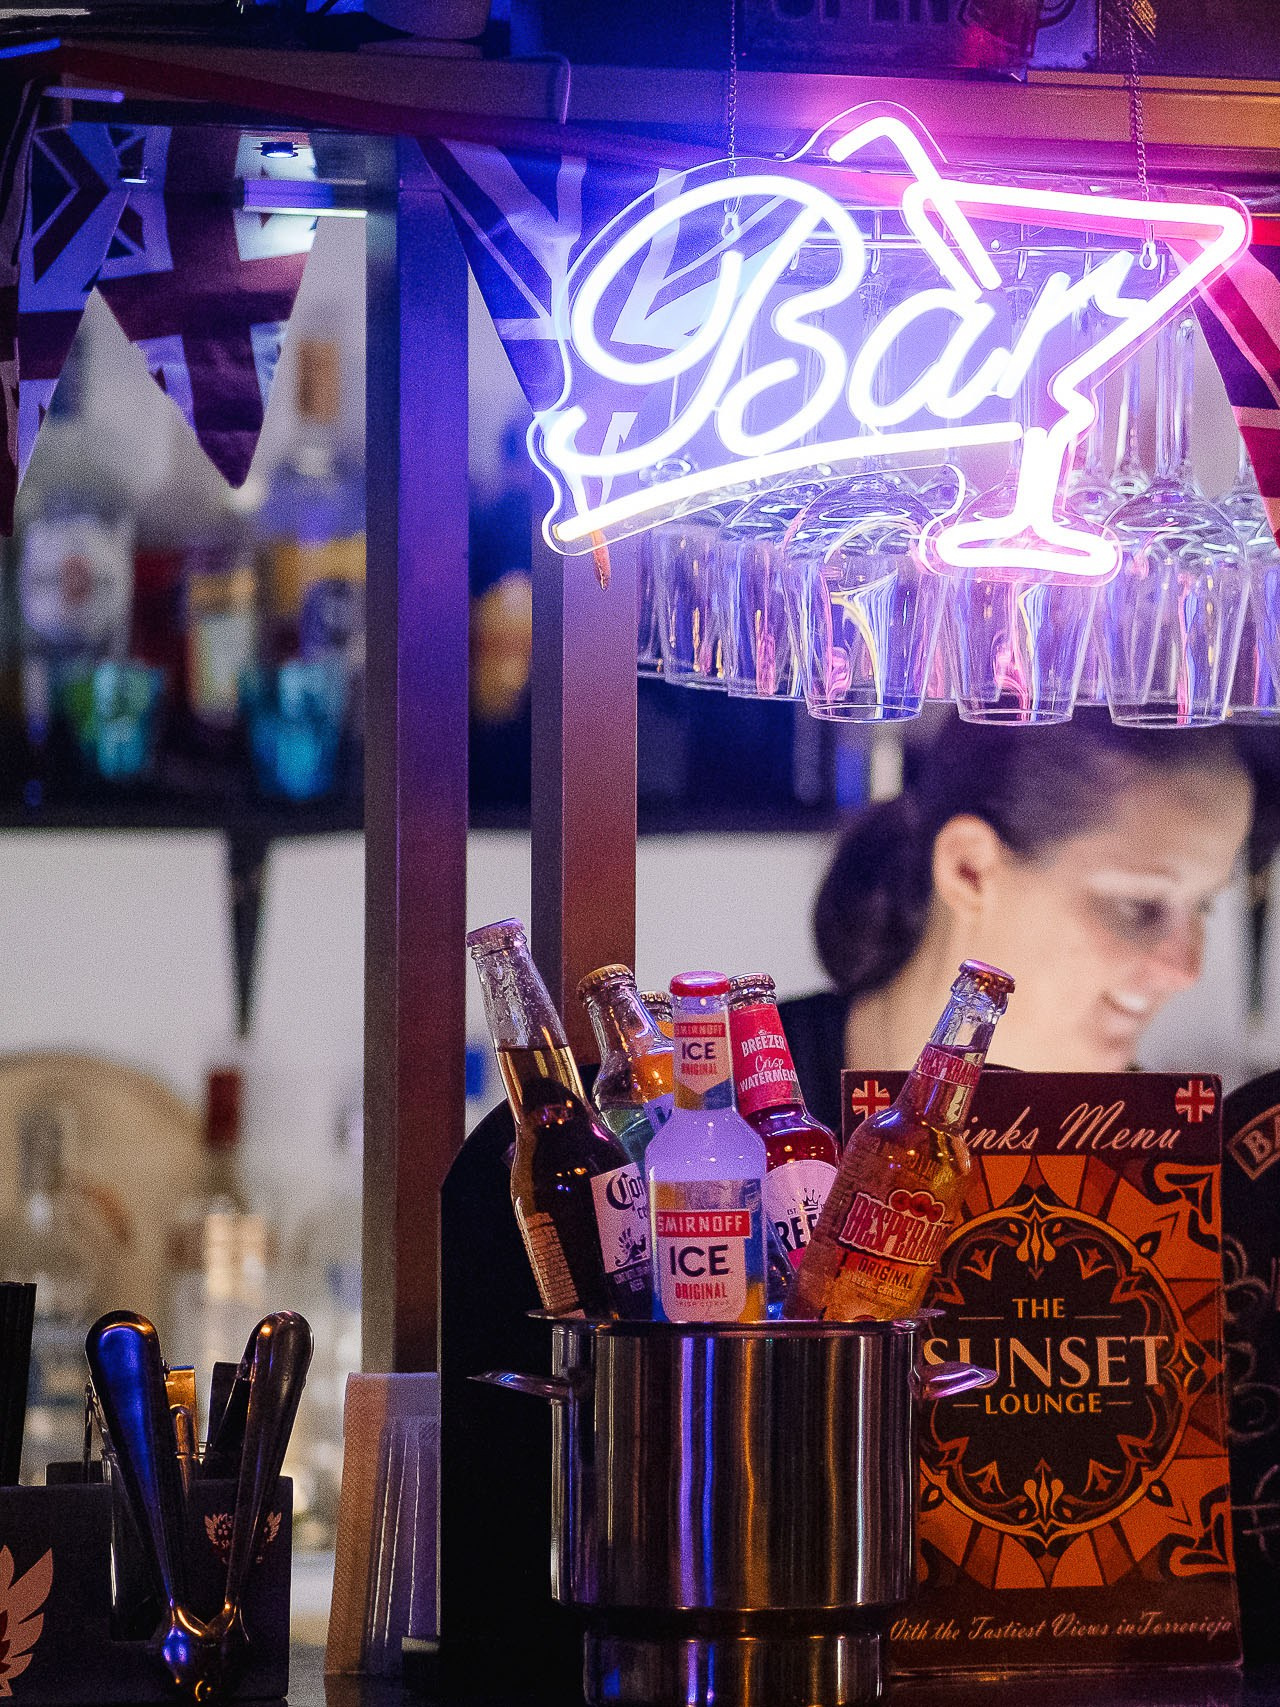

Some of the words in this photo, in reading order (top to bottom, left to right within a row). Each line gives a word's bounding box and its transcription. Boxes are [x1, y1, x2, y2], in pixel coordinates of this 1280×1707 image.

[545, 173, 1150, 477] Bar
[681, 1041, 717, 1060] ICE
[741, 1032, 788, 1058] BREEZER
[739, 1068, 799, 1093] WATERMELO
[964, 1105, 1041, 1151] inks
[1056, 1099, 1182, 1151] Menu
[657, 1214, 744, 1233] SMIRNOFF
[668, 1244, 731, 1278] ICE
[857, 1256, 913, 1290] ORIGINAL
[675, 1282, 728, 1300] ORIGINAL
[1011, 1298, 1066, 1319] THE
[984, 1393, 1103, 1415] LOUNGE
[931, 1618, 960, 1640] the
[967, 1616, 1047, 1640] Tastiest
[1051, 1612, 1108, 1638] Views
